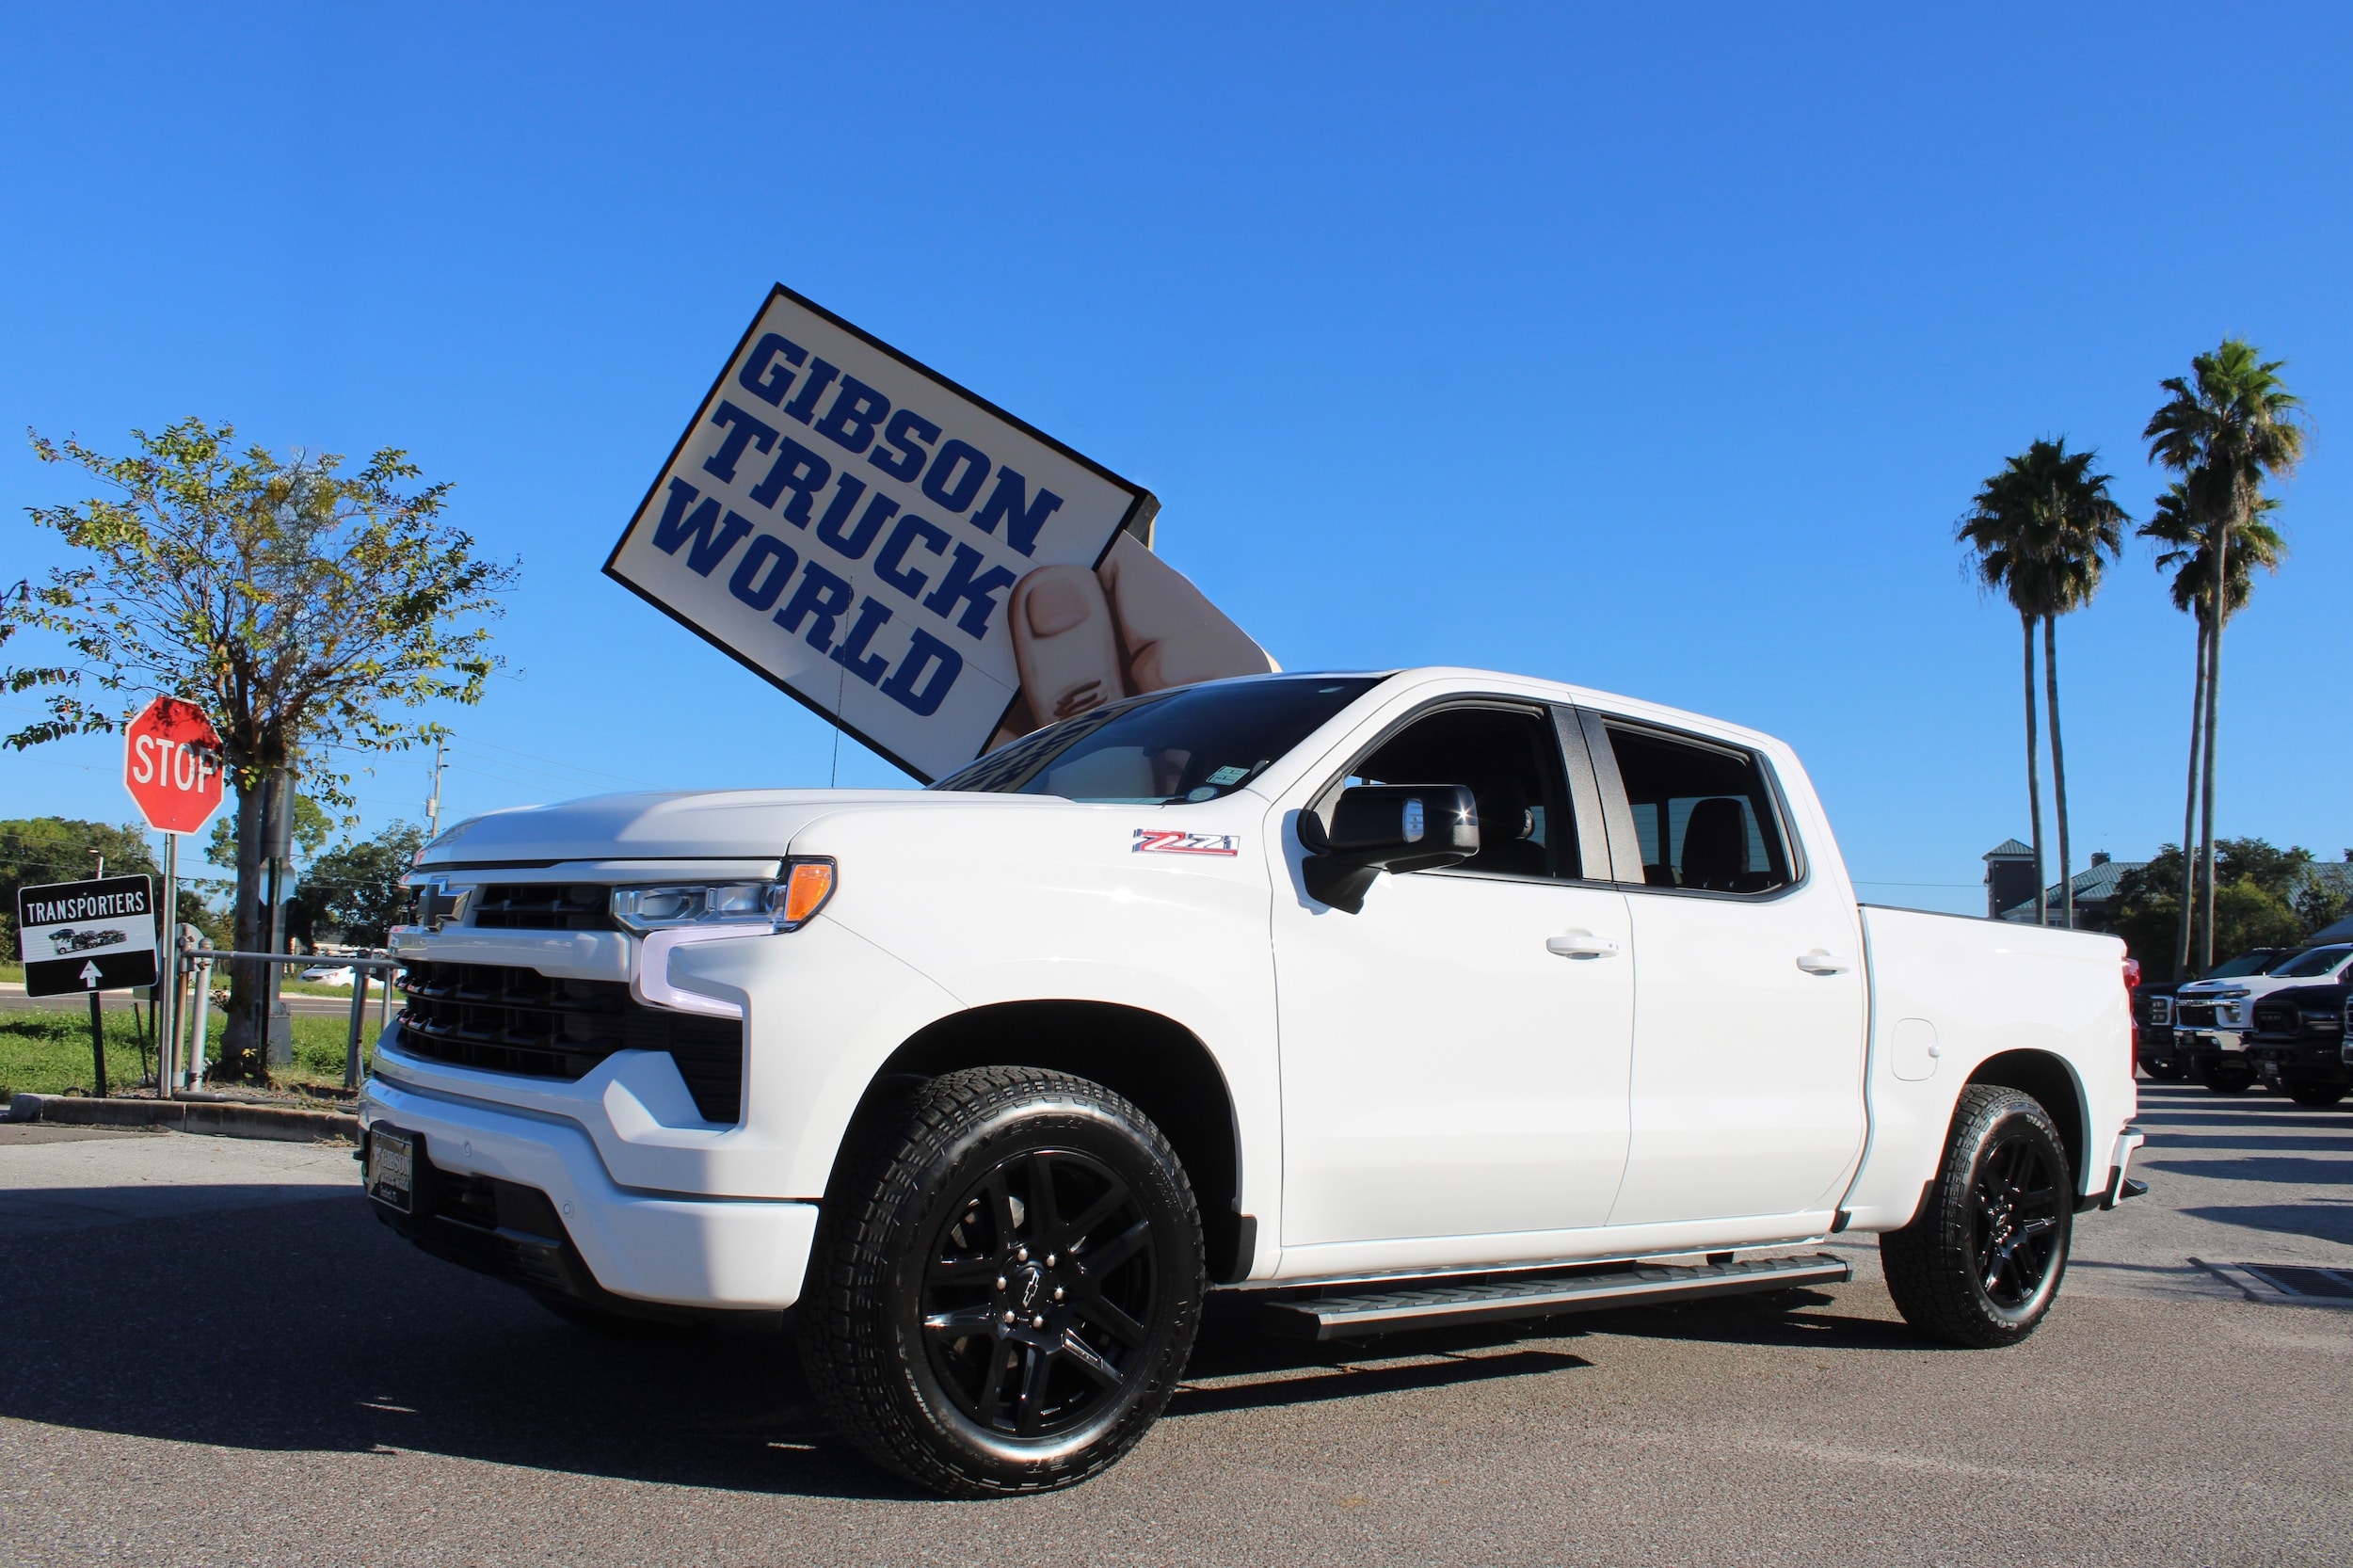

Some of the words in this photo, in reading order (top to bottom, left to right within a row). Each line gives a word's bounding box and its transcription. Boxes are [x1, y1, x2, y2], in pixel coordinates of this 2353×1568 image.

[738, 331, 1064, 559] GIBSON
[703, 398, 1016, 641] TRUCK
[649, 475, 965, 718] WORLD
[133, 734, 218, 793] STOP
[1132, 828, 1241, 856] Z71
[26, 890, 145, 923] TRANSPORTERS
[381, 1148, 410, 1176] GIBSON
